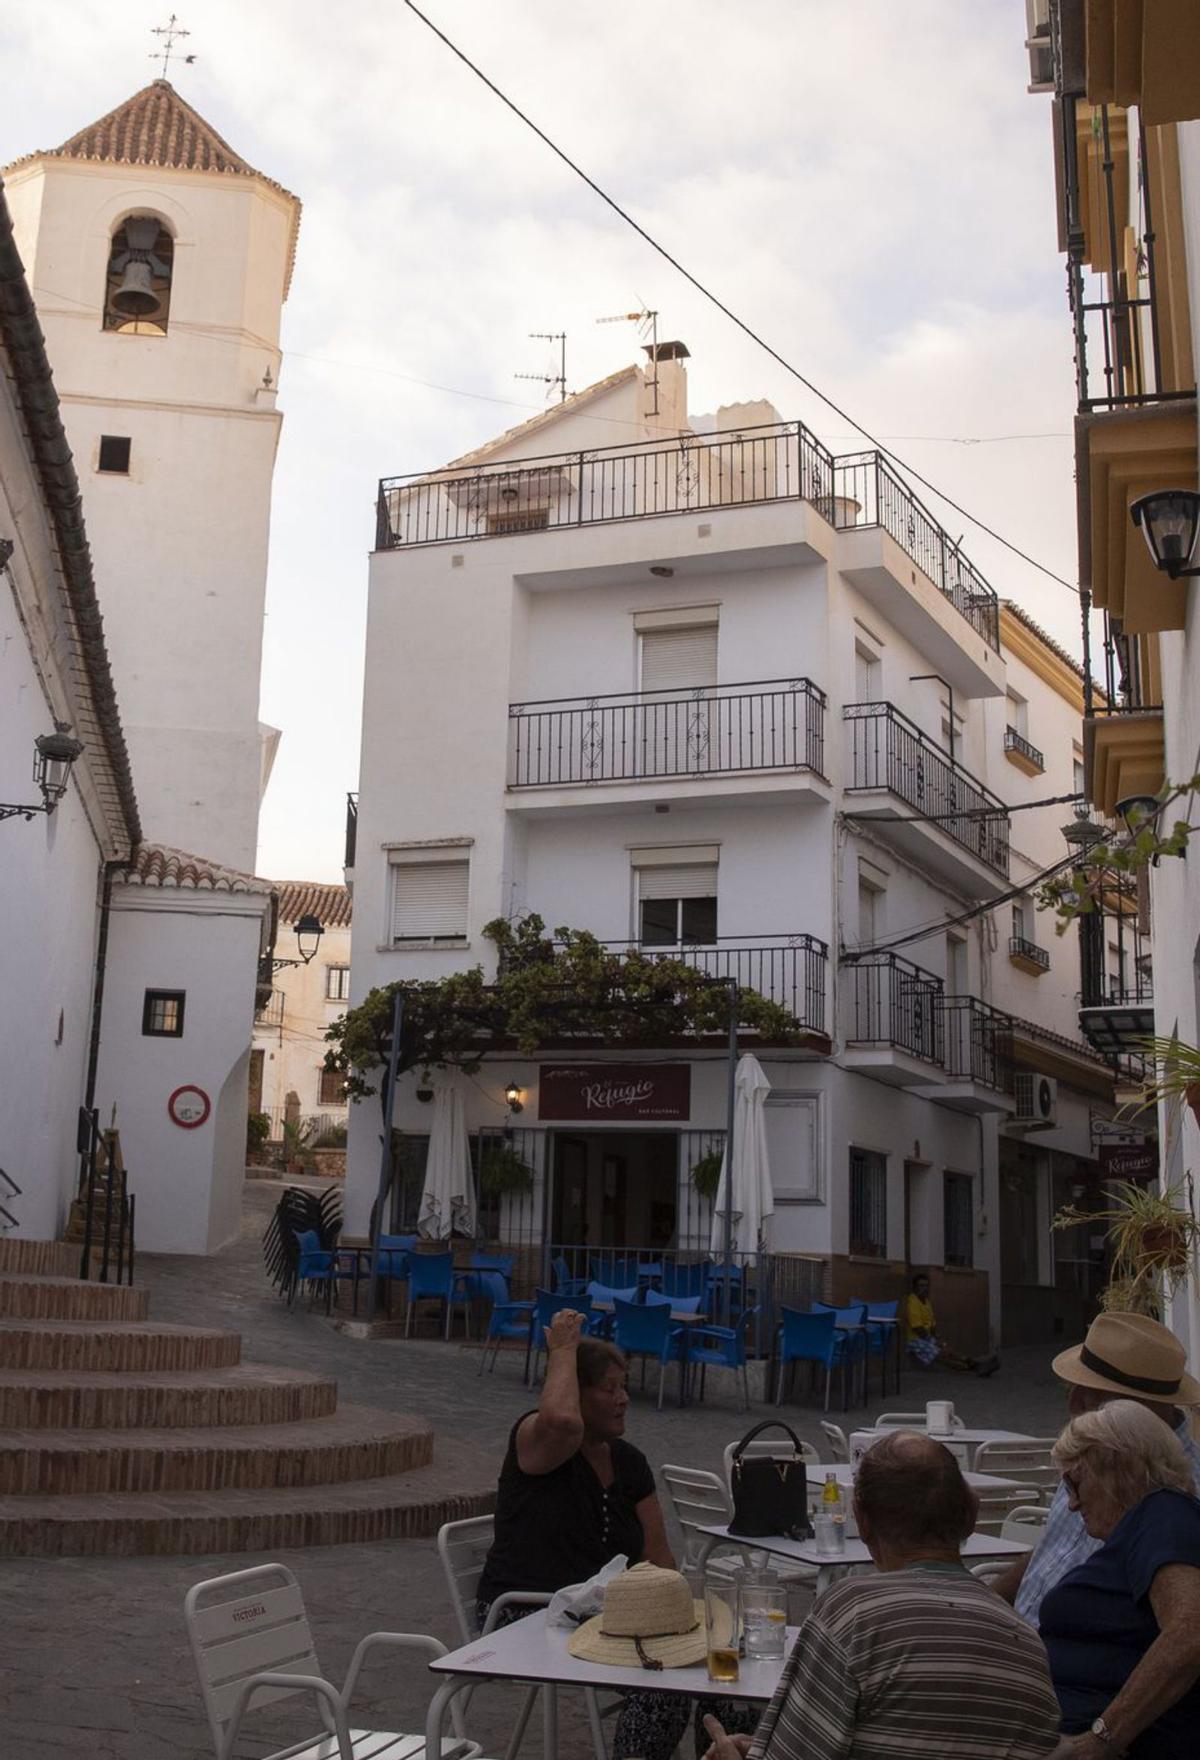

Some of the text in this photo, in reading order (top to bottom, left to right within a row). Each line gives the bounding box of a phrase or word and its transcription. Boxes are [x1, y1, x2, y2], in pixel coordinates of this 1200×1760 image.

[581, 1080, 654, 1109] Refugio
[1106, 1156, 1153, 1174] Refugio
[232, 1606, 266, 1622] VICTORIA
